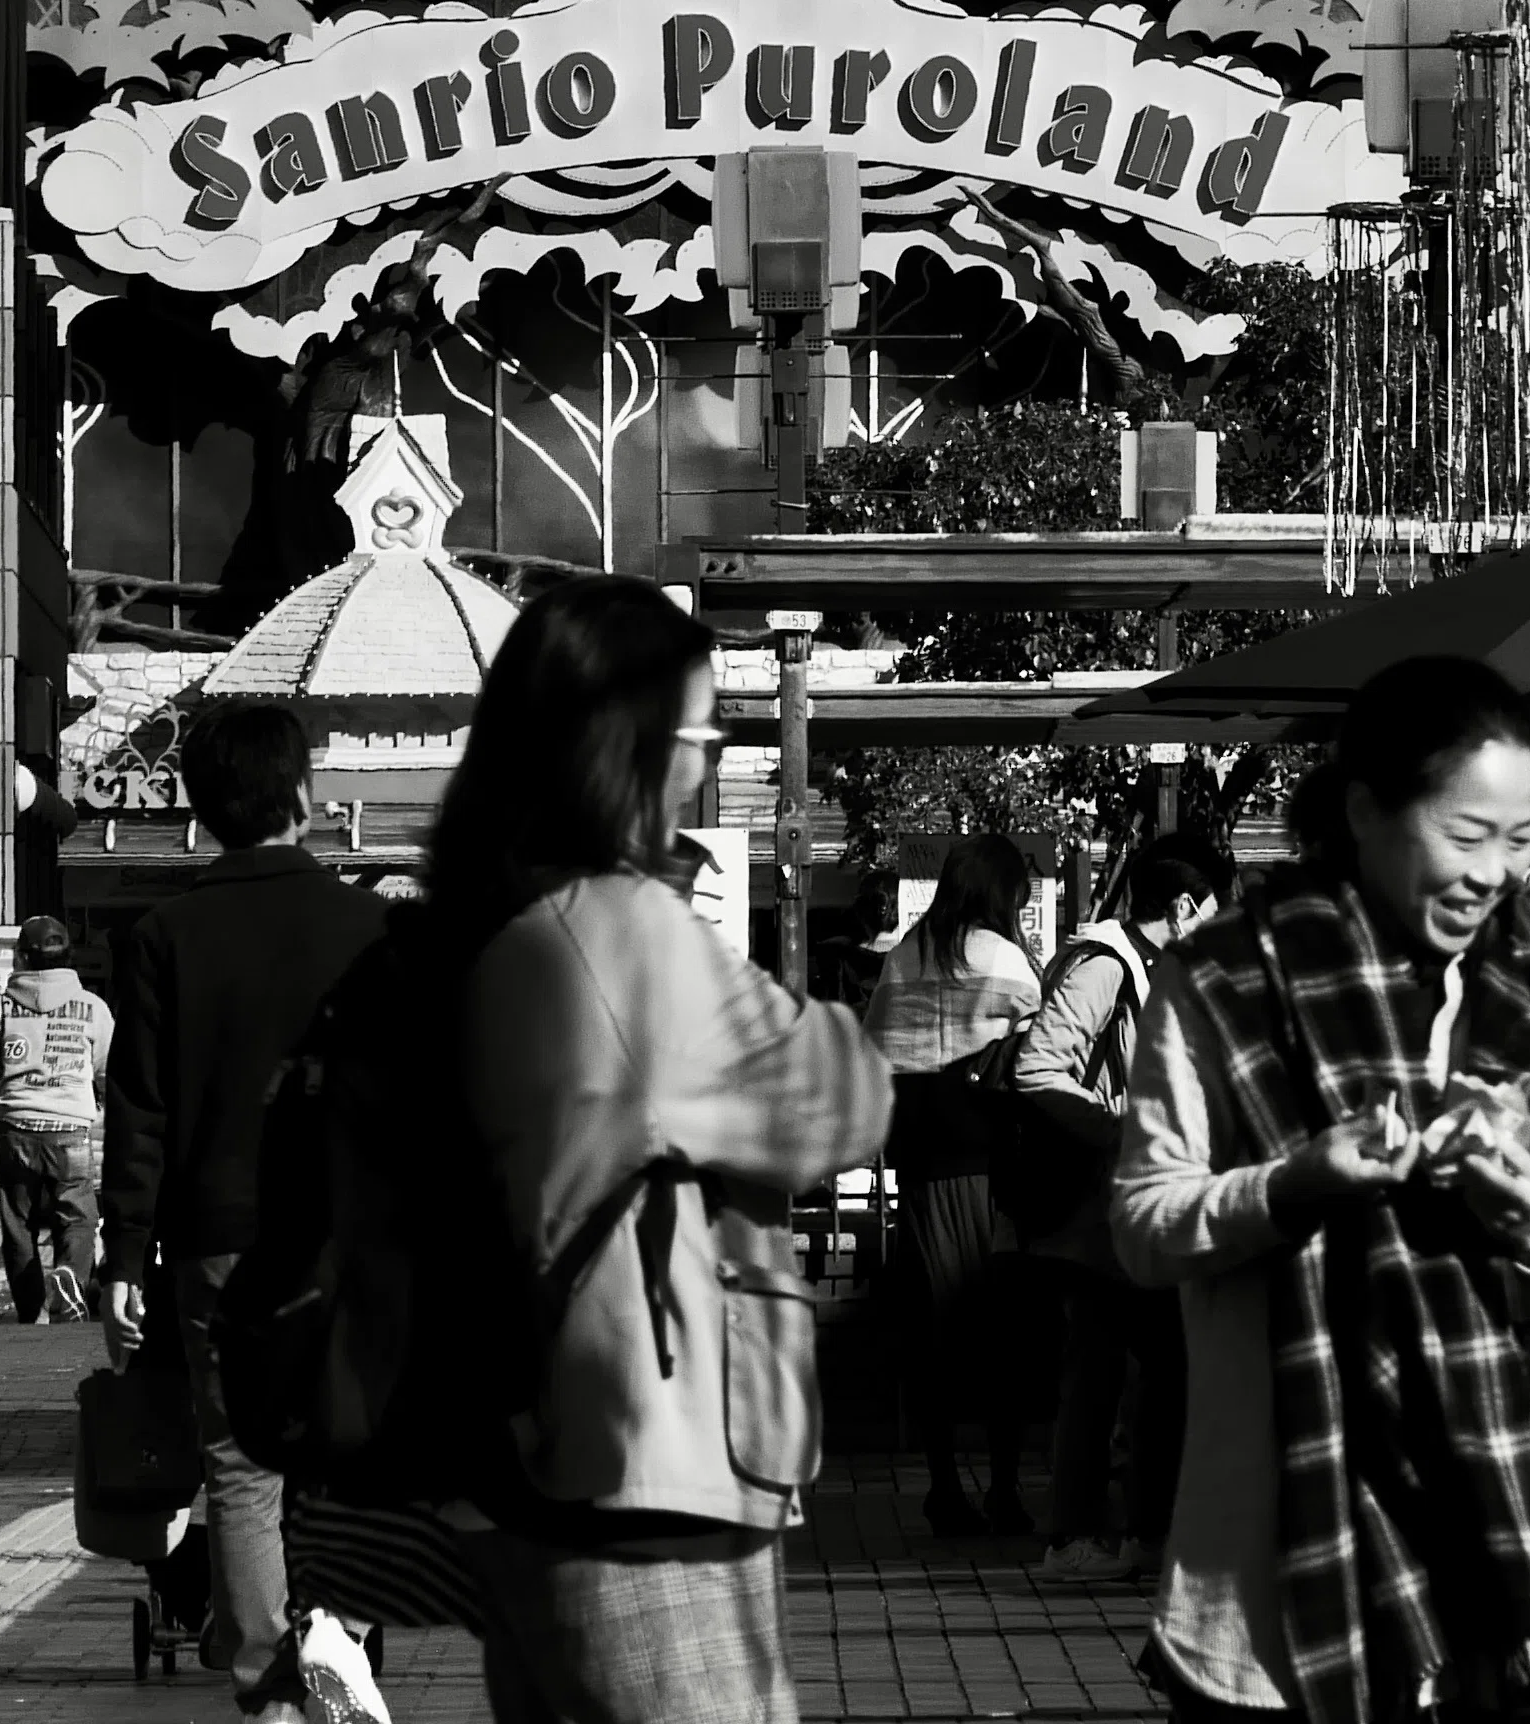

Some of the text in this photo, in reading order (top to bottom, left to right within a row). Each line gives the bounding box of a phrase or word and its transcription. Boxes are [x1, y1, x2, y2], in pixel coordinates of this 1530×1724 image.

[169, 12, 1292, 231] Sanrio Puroland
[792, 614, 807, 628] 53
[5, 1039, 26, 1059] 76
